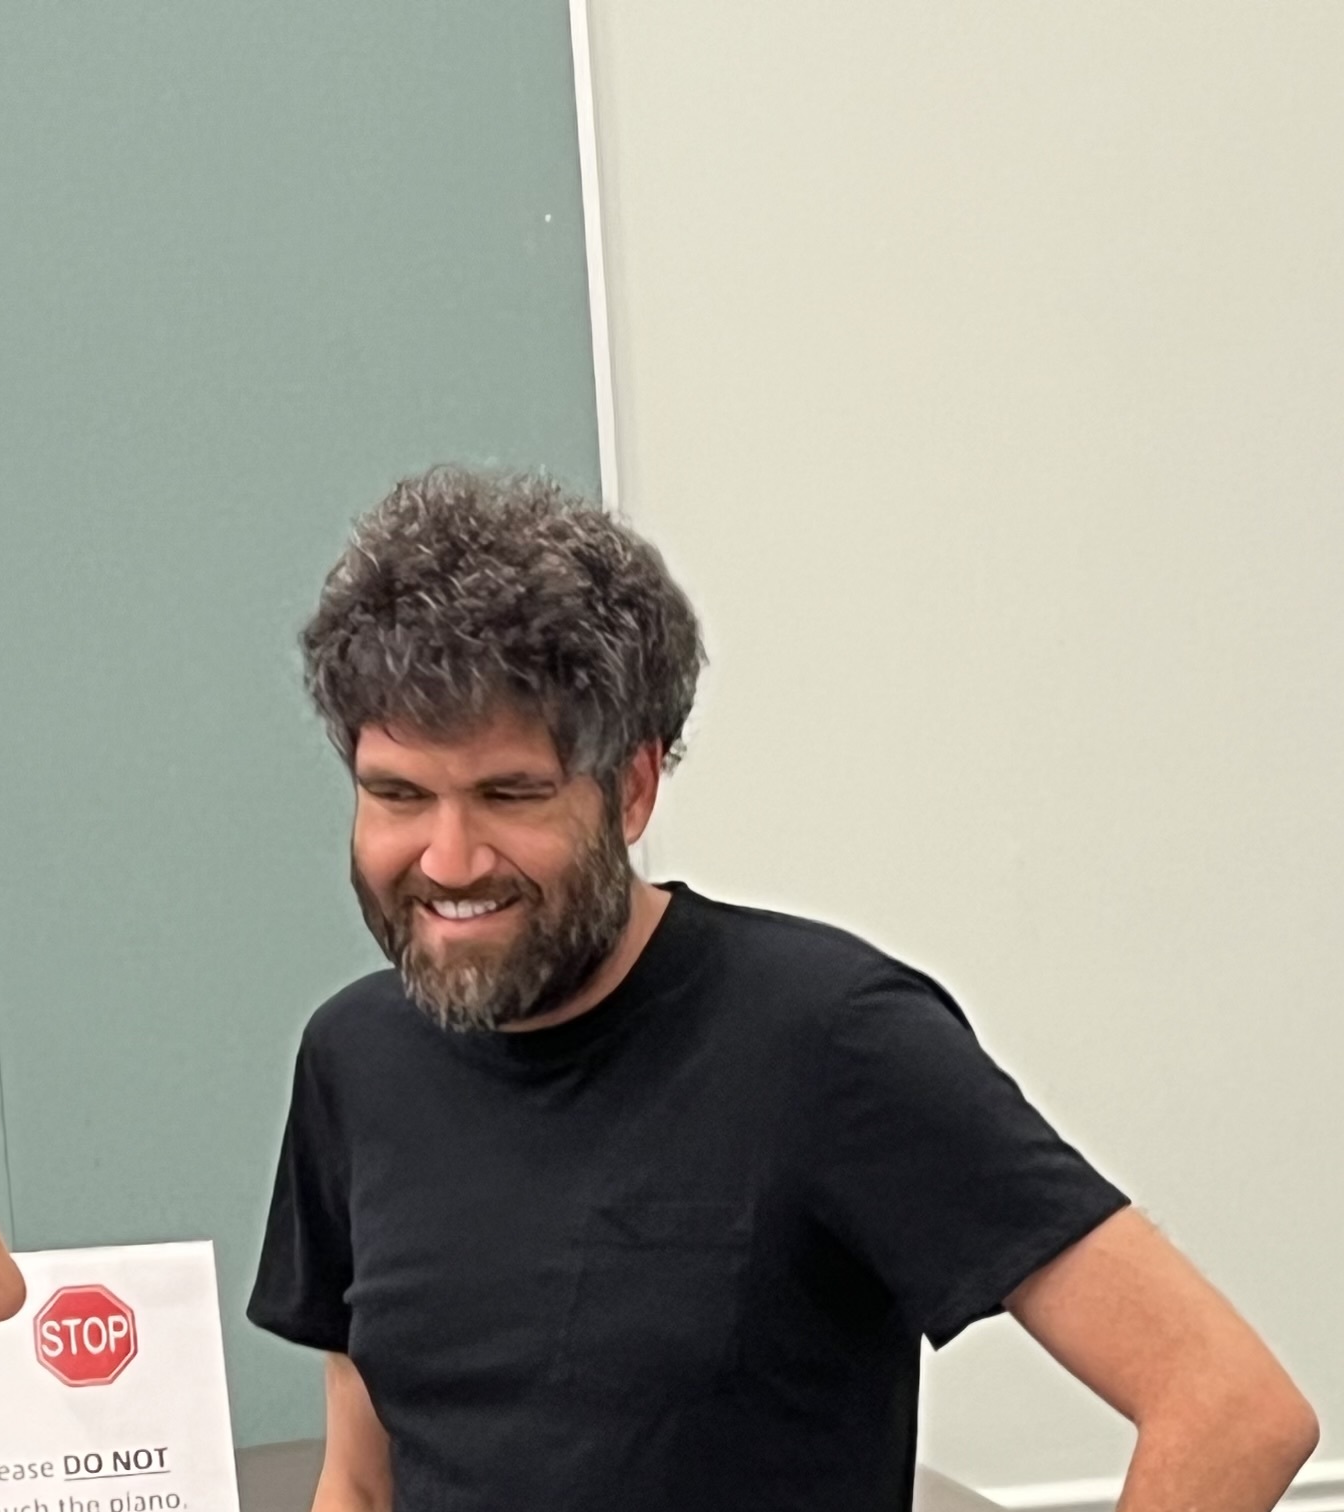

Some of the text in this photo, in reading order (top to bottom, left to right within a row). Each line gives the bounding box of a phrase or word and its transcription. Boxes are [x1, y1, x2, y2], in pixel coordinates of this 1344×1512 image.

[40, 1314, 130, 1358] STOP
[63, 1453, 104, 1478] DO
[112, 1447, 169, 1474] NOT
